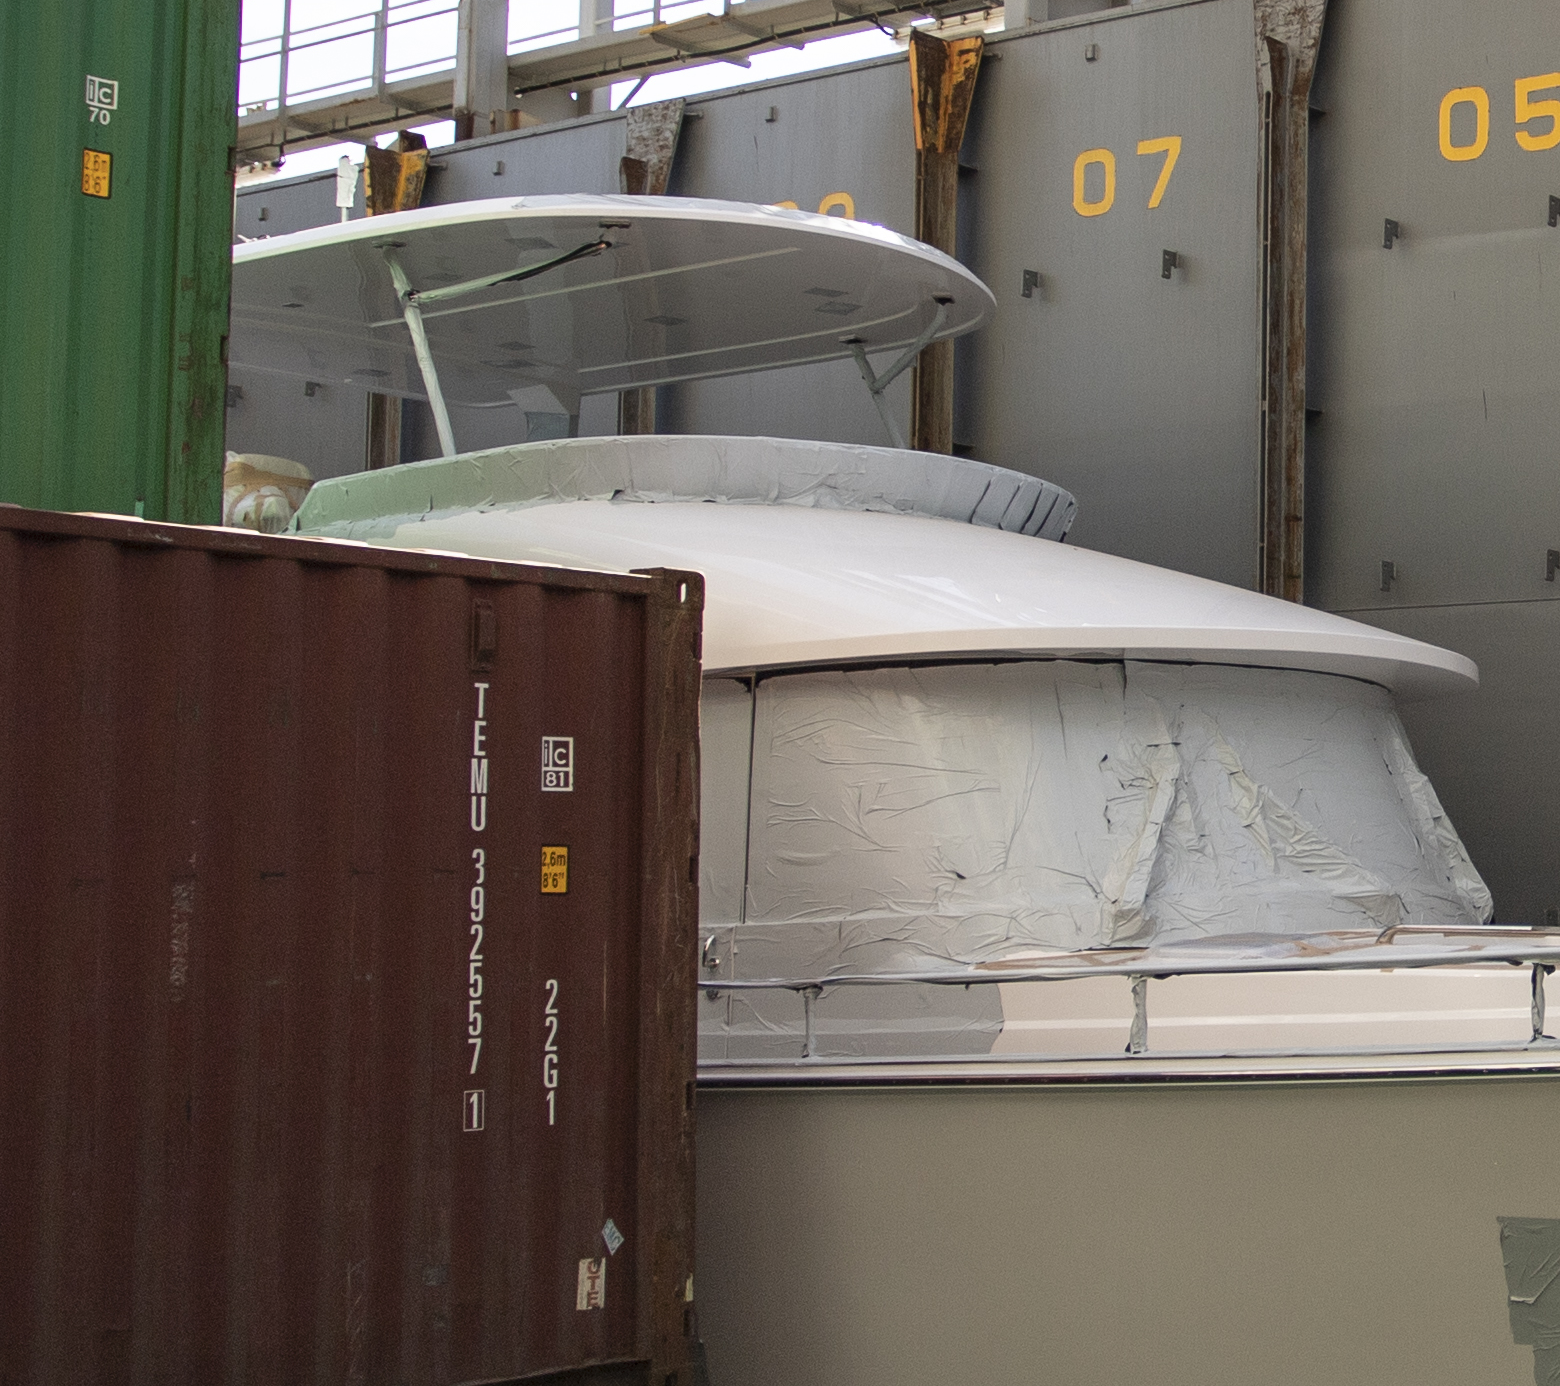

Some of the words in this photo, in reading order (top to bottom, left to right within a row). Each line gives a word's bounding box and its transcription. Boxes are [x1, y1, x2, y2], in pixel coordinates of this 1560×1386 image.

[89, 107, 111, 125] 70
[1072, 135, 1183, 217] 07
[470, 683, 489, 831] TEMU
[545, 772, 564, 787] 81
[468, 849, 485, 1074] 392557
[544, 979, 558, 1125] 22G1
